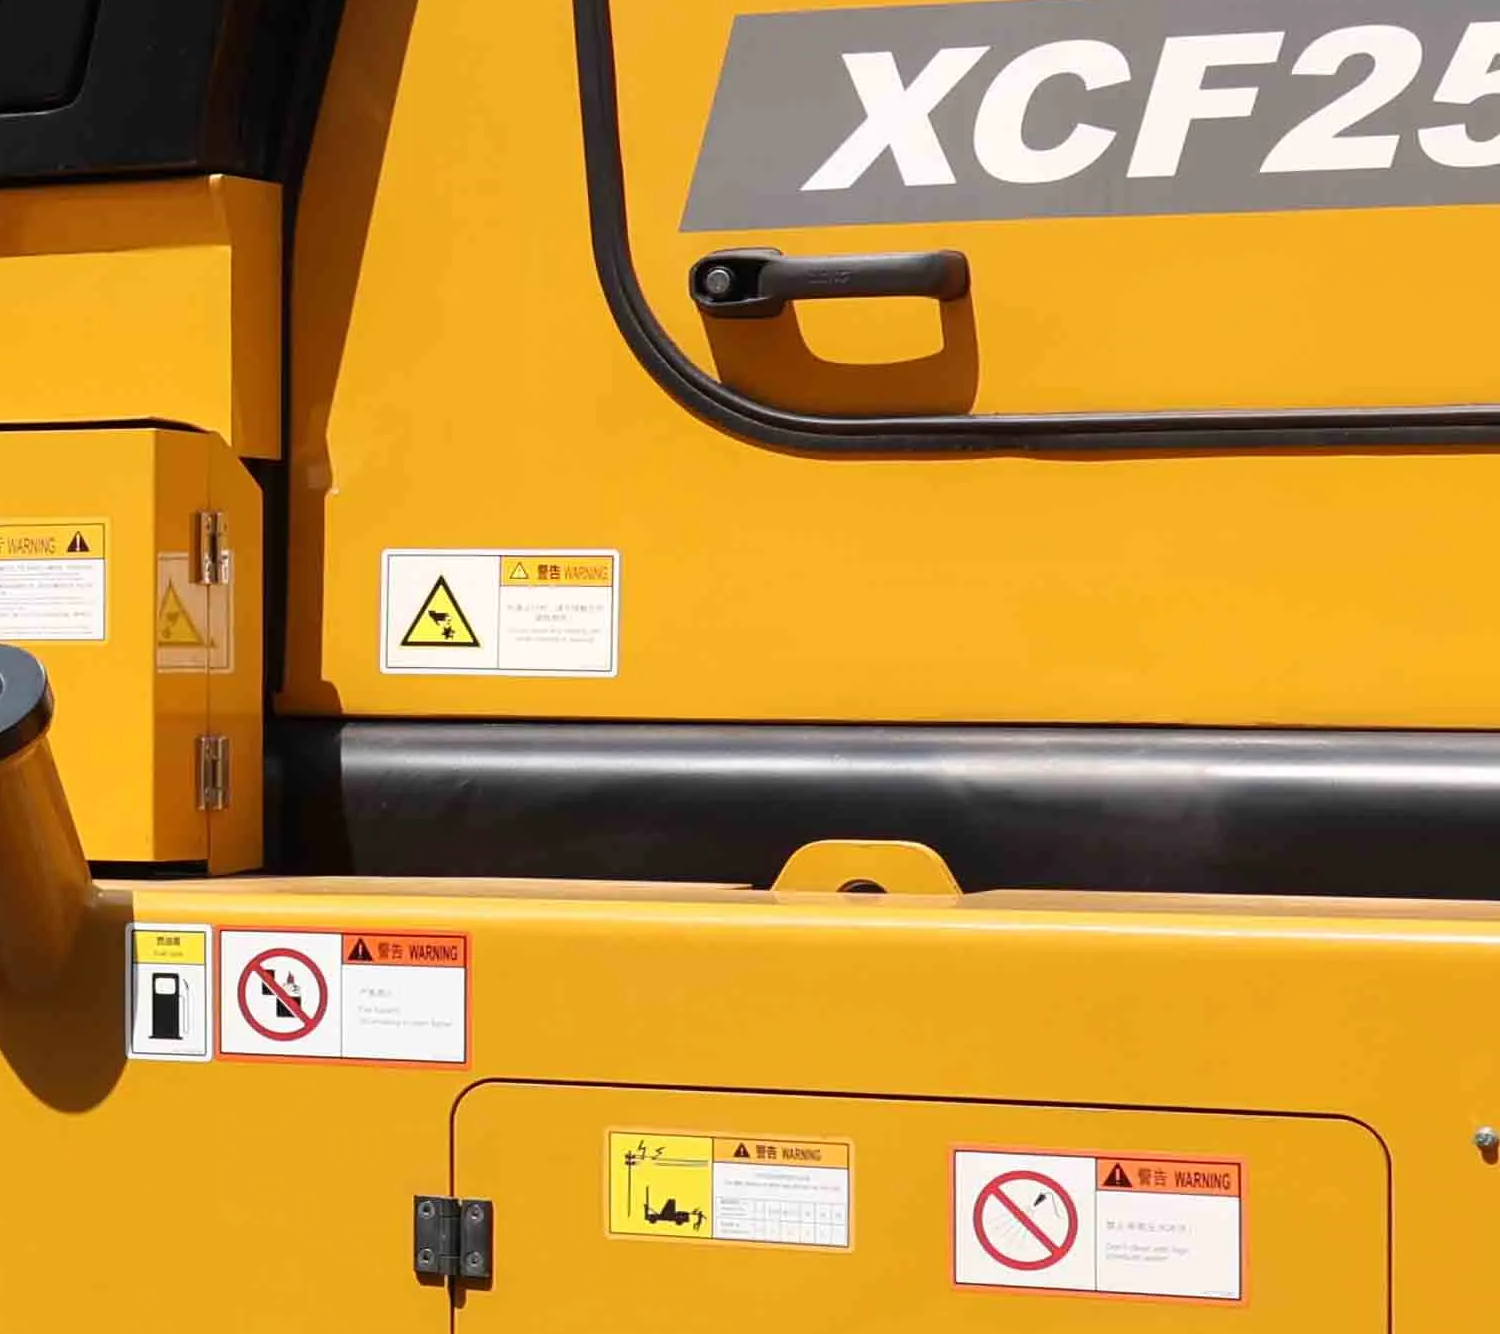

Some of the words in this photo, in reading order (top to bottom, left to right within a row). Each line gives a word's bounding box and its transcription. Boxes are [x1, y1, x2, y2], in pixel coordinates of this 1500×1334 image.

[799, 21, 1500, 191] XCF25
[7, 537, 56, 555] WARNING
[564, 564, 609, 581] WARNING
[409, 943, 458, 962] WARNING
[781, 1147, 822, 1162] WARNING
[1137, 1167, 1168, 1188] 警告
[1174, 1170, 1231, 1190] WARNING
